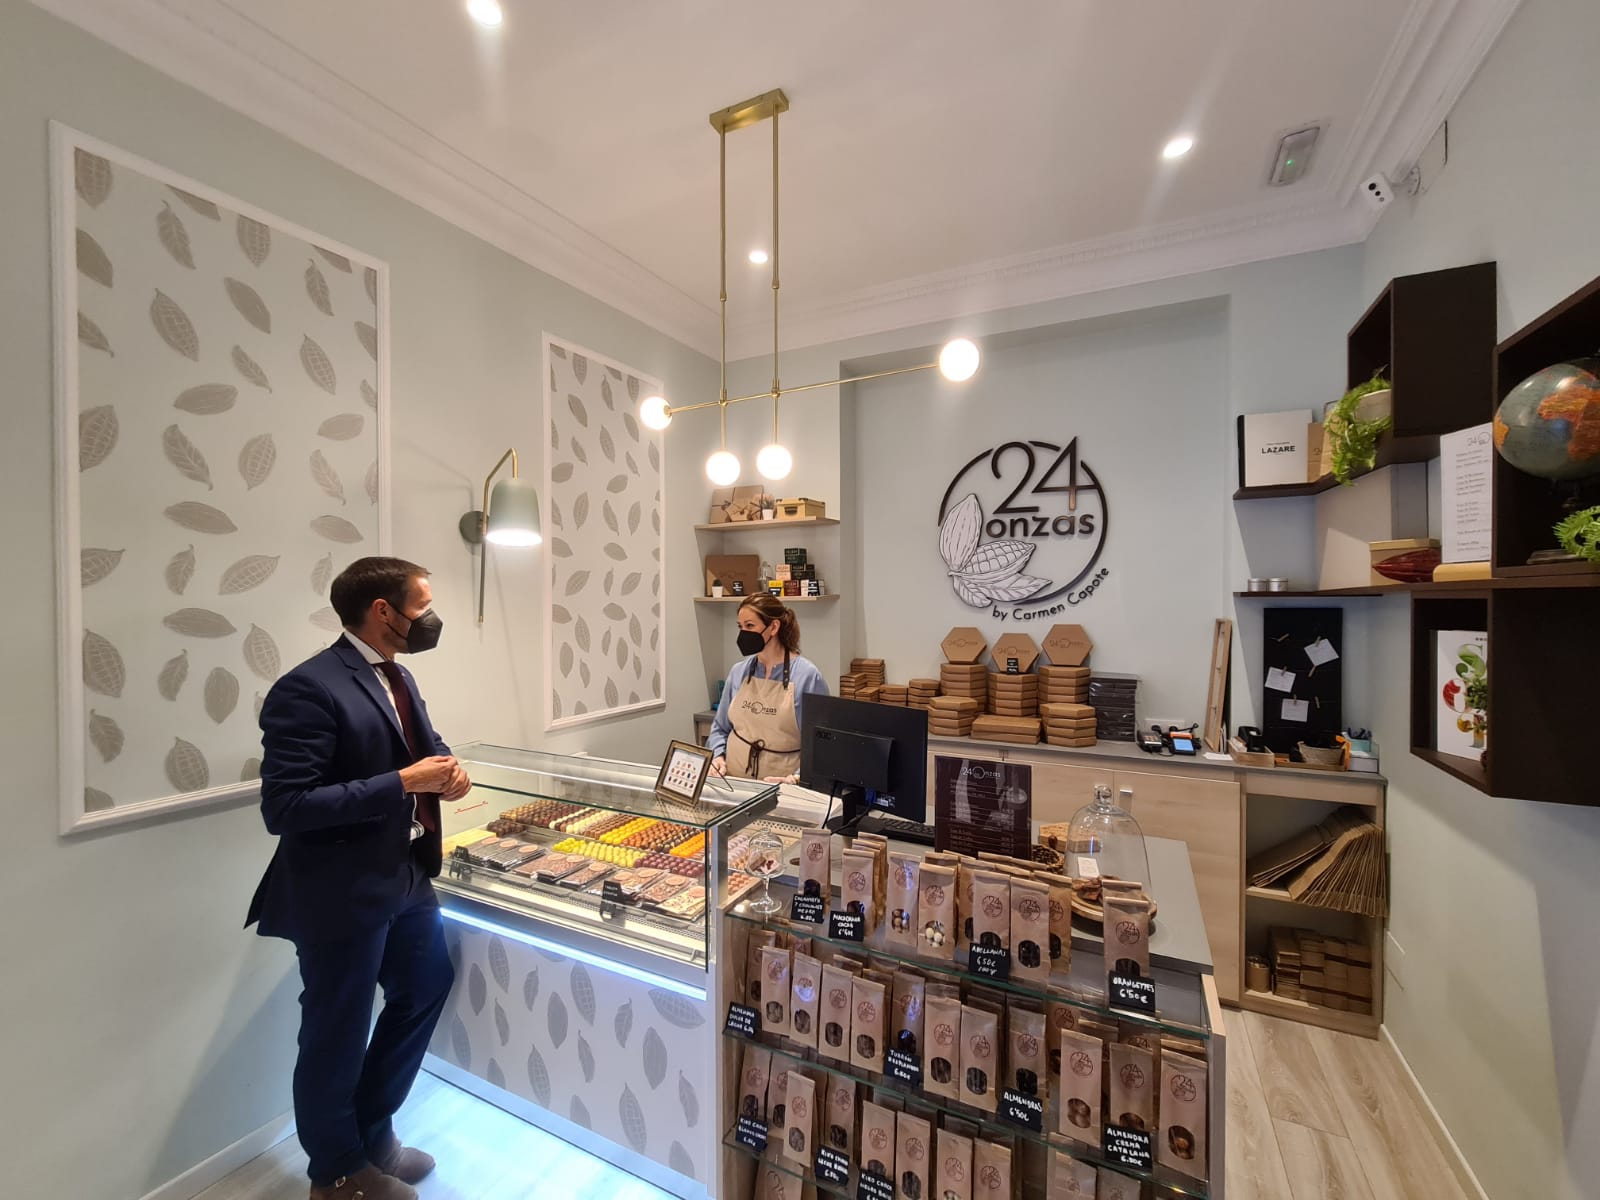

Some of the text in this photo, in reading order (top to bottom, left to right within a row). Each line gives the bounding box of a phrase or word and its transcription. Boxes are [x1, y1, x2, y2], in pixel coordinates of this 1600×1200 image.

[1261, 445, 1296, 454] LAZARE
[991, 436, 1099, 514] 24
[986, 513, 1095, 538] onzas
[992, 567, 1110, 622] by Carmen Capote
[1004, 1091, 1042, 1112] ALMENDRAS
[1107, 1127, 1149, 1144] ALMENDRA
[1107, 1144, 1150, 1158] CATALANA
